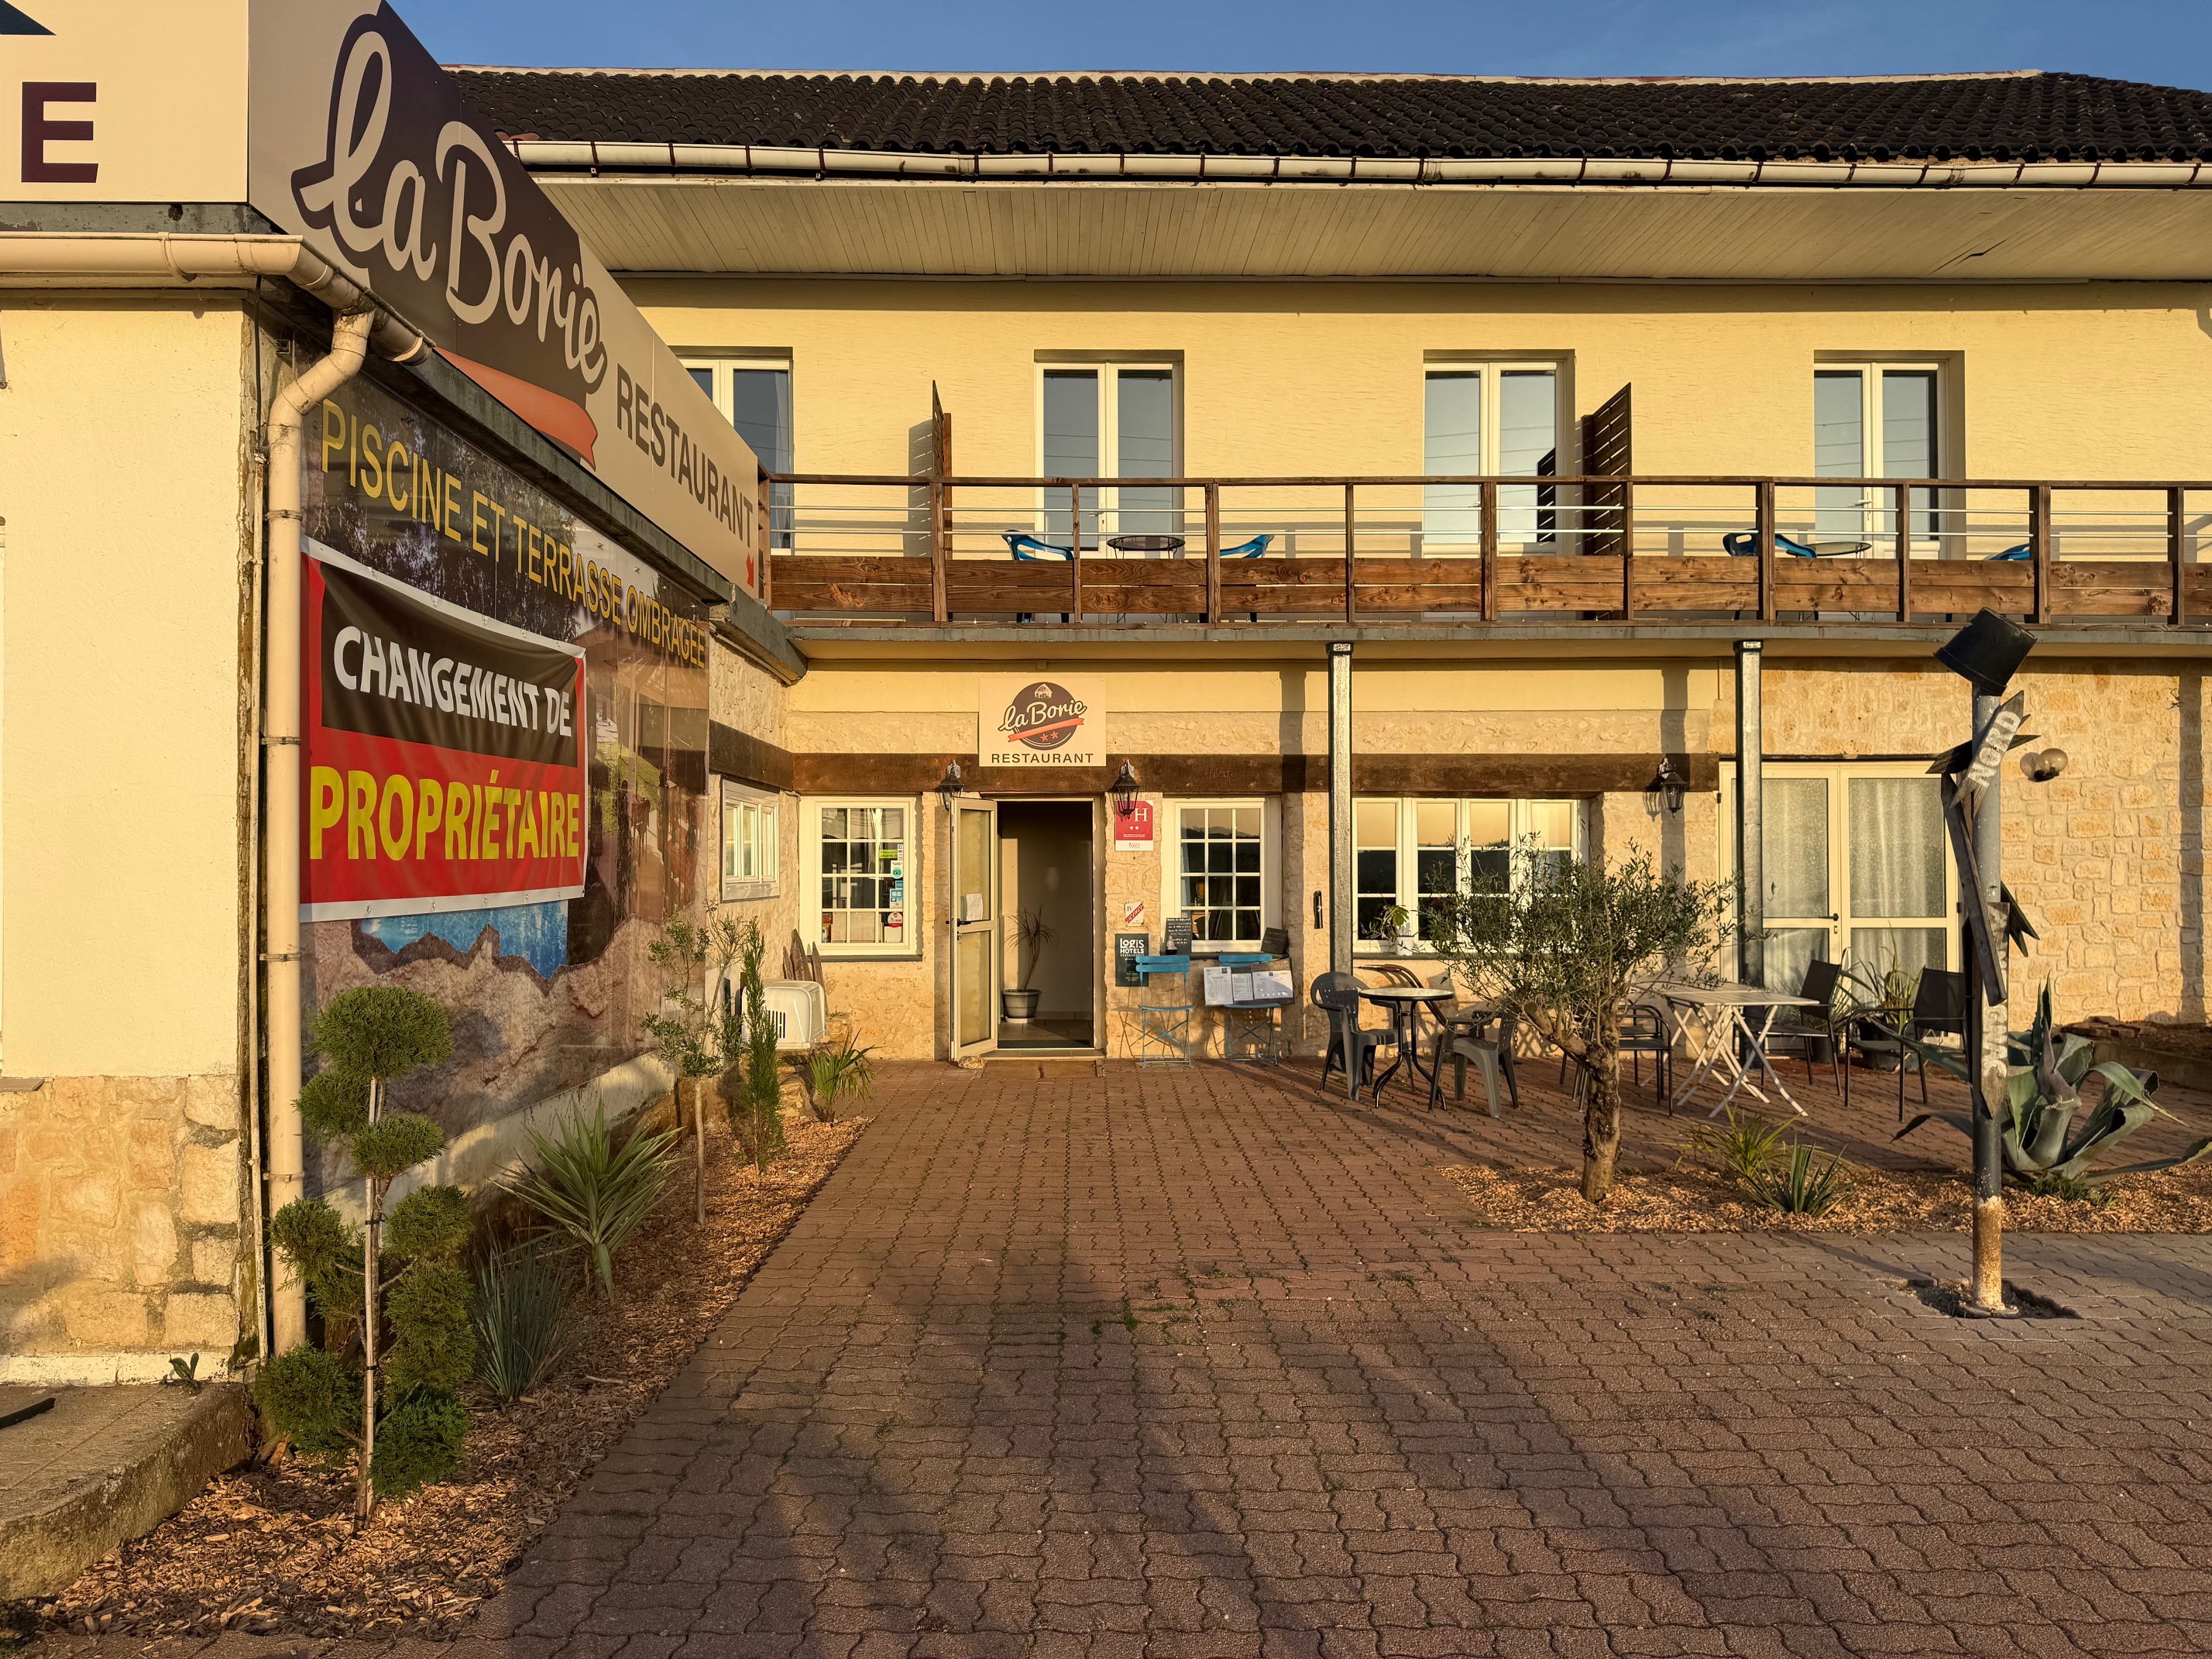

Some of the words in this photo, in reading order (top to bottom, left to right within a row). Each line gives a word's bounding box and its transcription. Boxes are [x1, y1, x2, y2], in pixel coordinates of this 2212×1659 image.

[22, 82, 98, 183] E
[299, 31, 437, 280] la
[436, 121, 605, 375] Borie
[617, 364, 754, 549] RESTAURANT
[321, 400, 462, 543] PISCINE
[472, 490, 506, 557] ET
[513, 514, 622, 626] TERRASSE
[627, 584, 706, 669] OMBRAGÉE
[333, 626, 540, 731] CHANGEMENT
[546, 686, 572, 737] DE
[998, 705, 1029, 731] la
[1026, 699, 1087, 726] Borie
[991, 753, 1094, 763] RESTAURANT
[1967, 710, 2021, 788] NORD
[310, 765, 580, 861] PROPRIÉTAIRE
[1134, 808, 1148, 822] H
